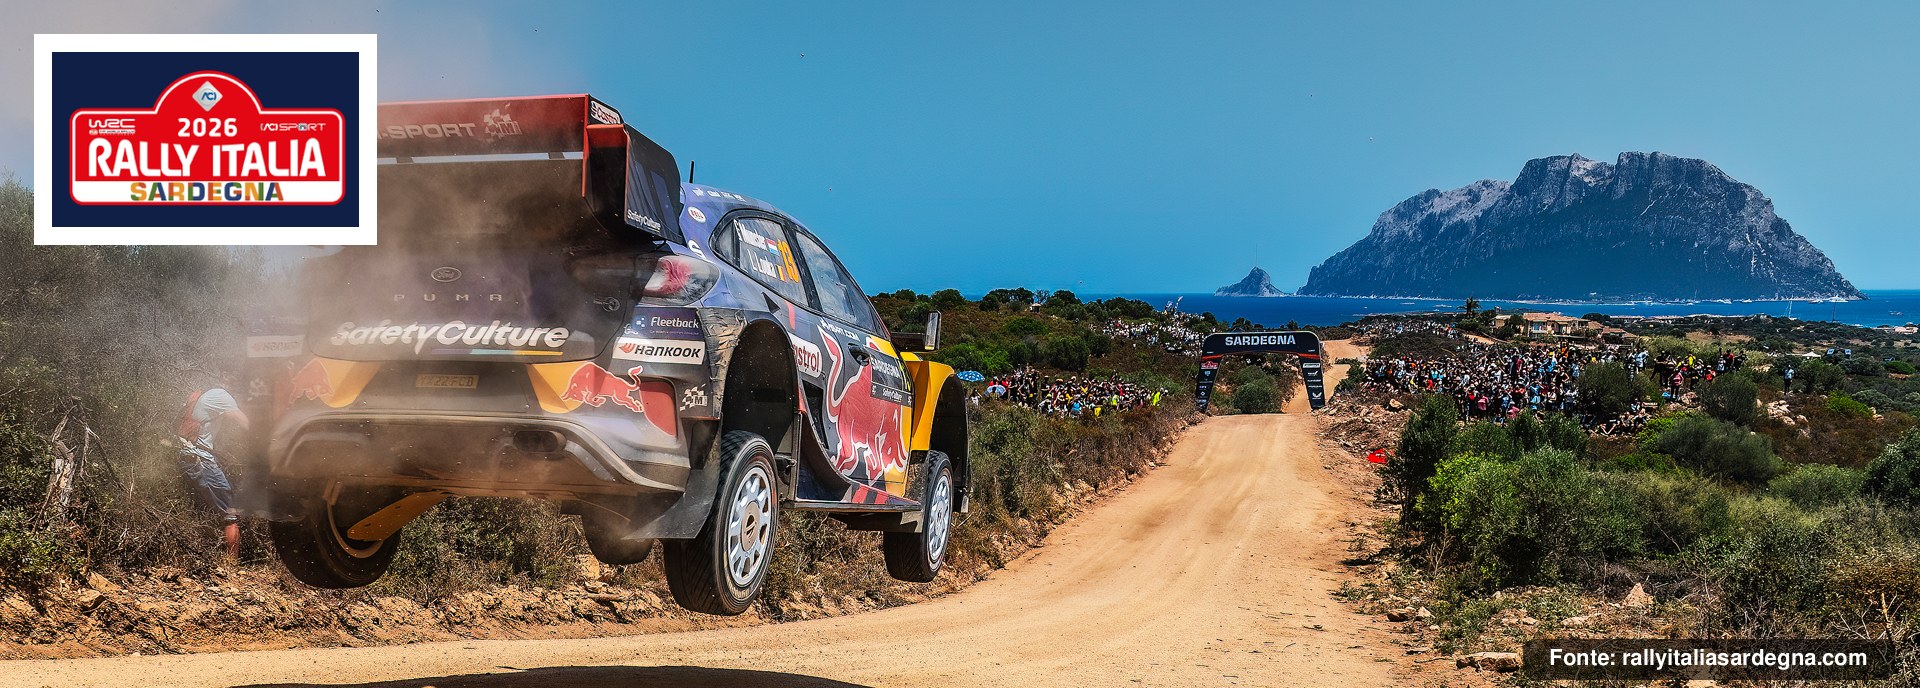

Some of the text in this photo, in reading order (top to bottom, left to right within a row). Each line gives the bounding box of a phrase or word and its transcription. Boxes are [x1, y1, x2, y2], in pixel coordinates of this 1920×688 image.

[777, 239, 799, 283] 13
[394, 294, 502, 302] PUMA
[650, 316, 699, 328] Fleetback
[330, 319, 570, 355] SafetyCulture
[1225, 334, 1296, 346] SARDEGNA
